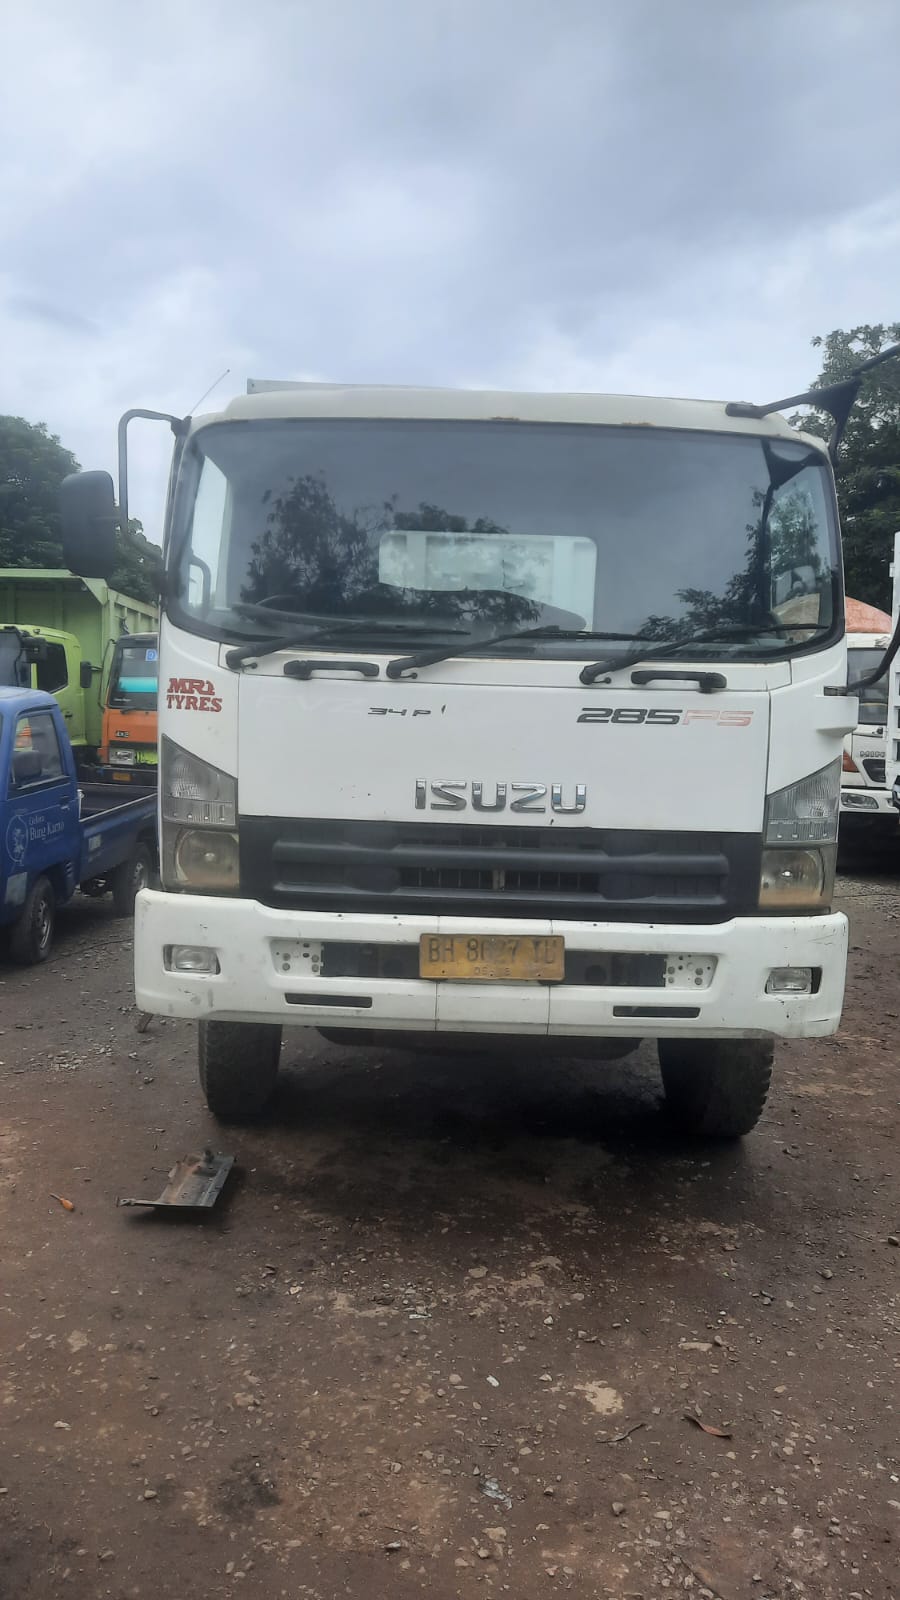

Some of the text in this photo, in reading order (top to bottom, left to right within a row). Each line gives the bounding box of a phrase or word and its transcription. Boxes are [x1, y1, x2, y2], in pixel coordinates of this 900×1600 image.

[167, 695, 222, 712] TYRES
[415, 778, 587, 815] ISUZU
[429, 938, 455, 962] BH
